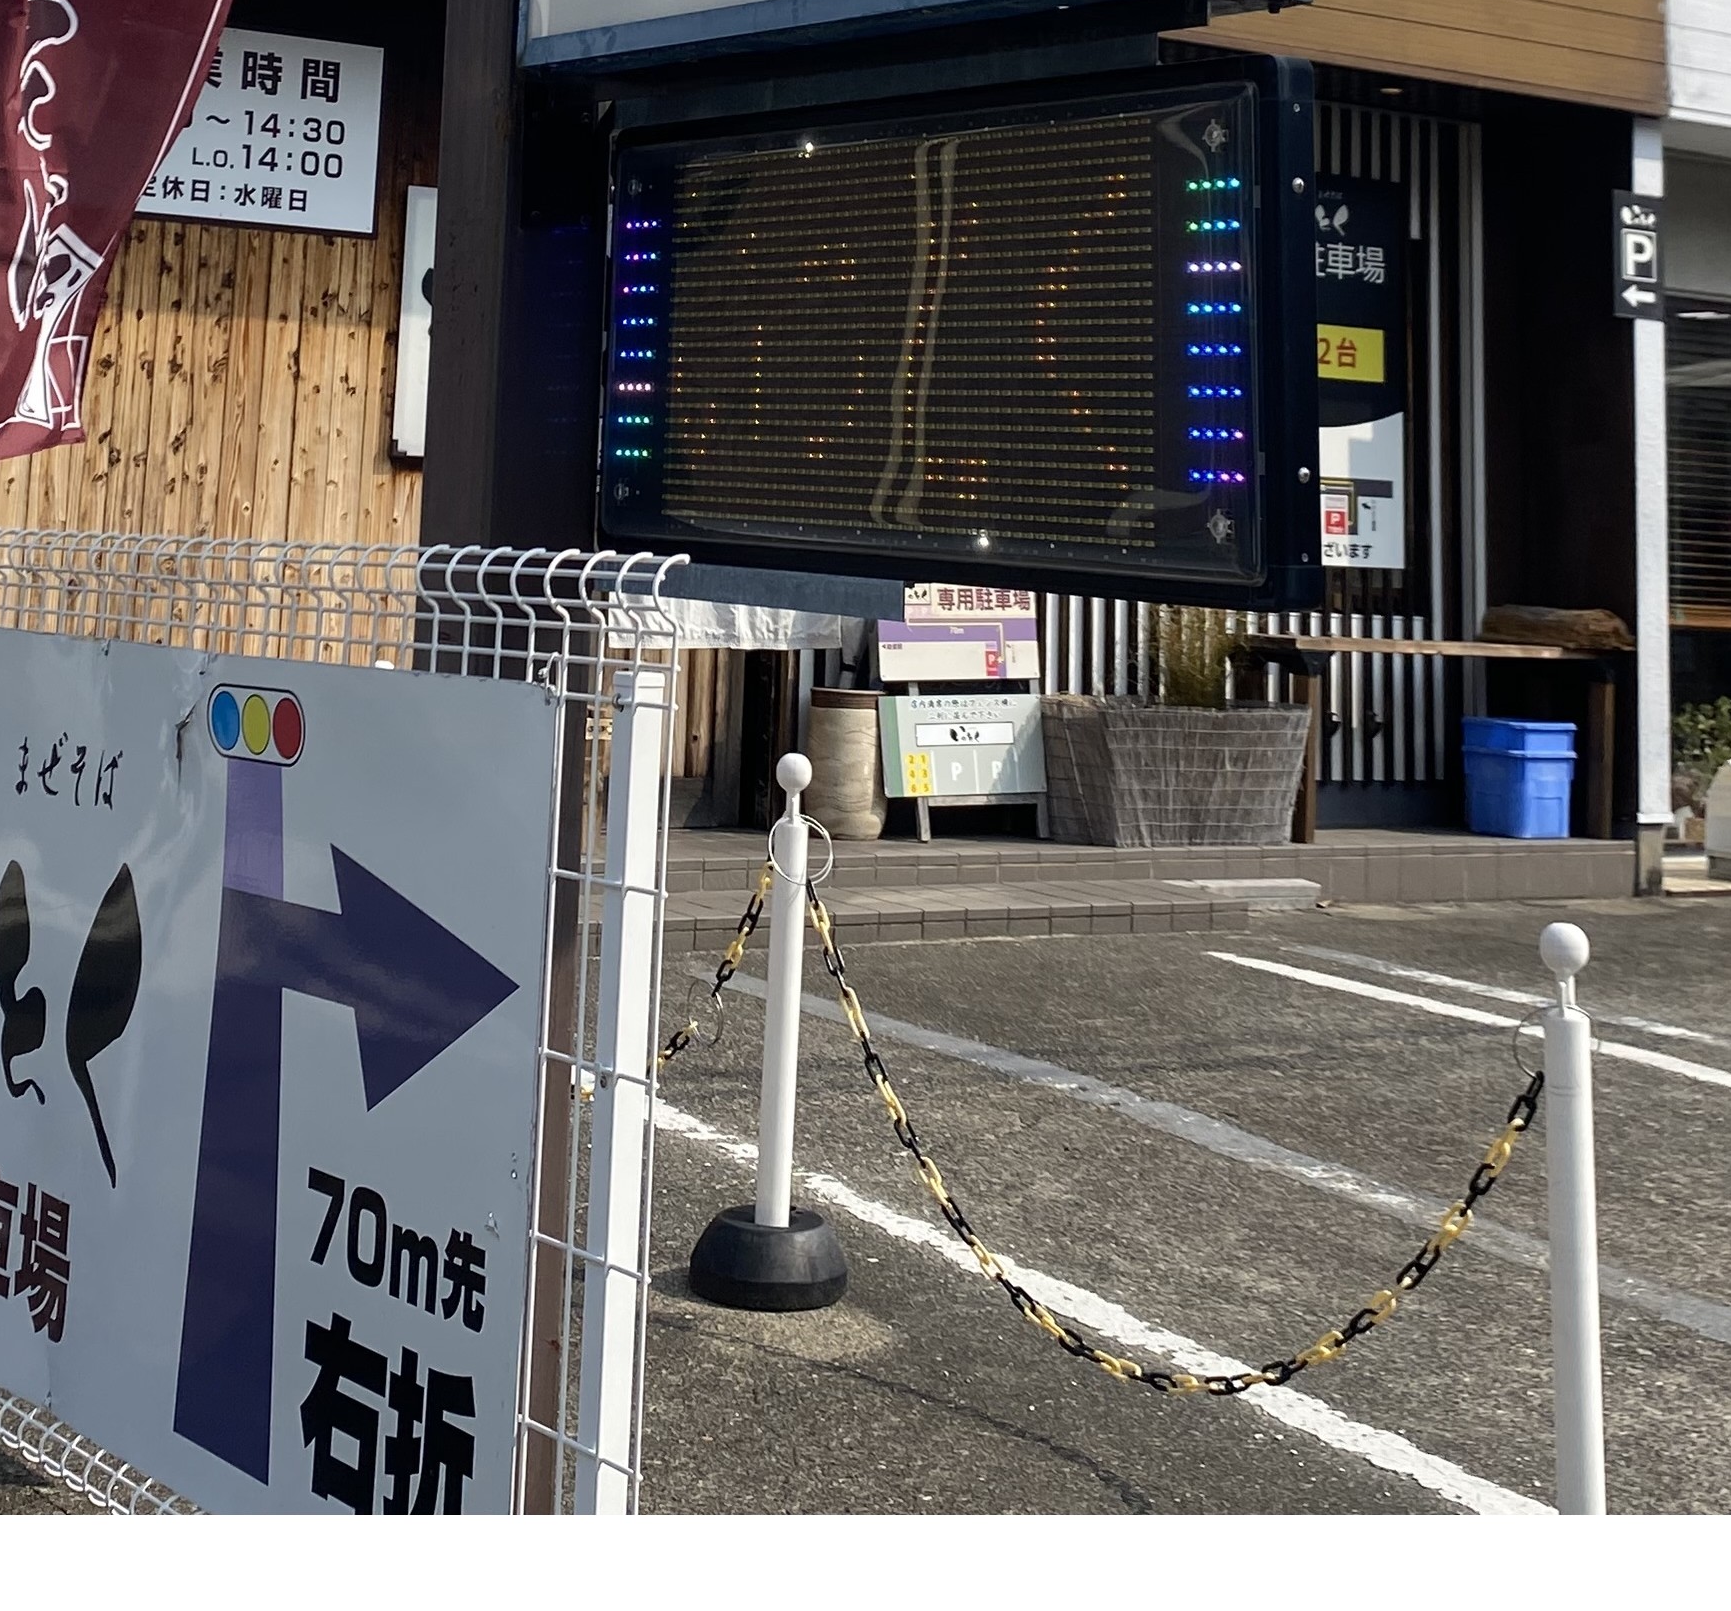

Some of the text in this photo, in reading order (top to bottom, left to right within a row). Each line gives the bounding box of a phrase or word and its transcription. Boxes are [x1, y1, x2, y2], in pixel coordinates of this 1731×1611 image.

[1626, 232, 1653, 275] P
[937, 587, 1031, 612] 専用駐車場
[13, 731, 125, 812] まぜそば
[305, 1166, 489, 1334] 70m先
[297, 1311, 479, 1515] 右折
